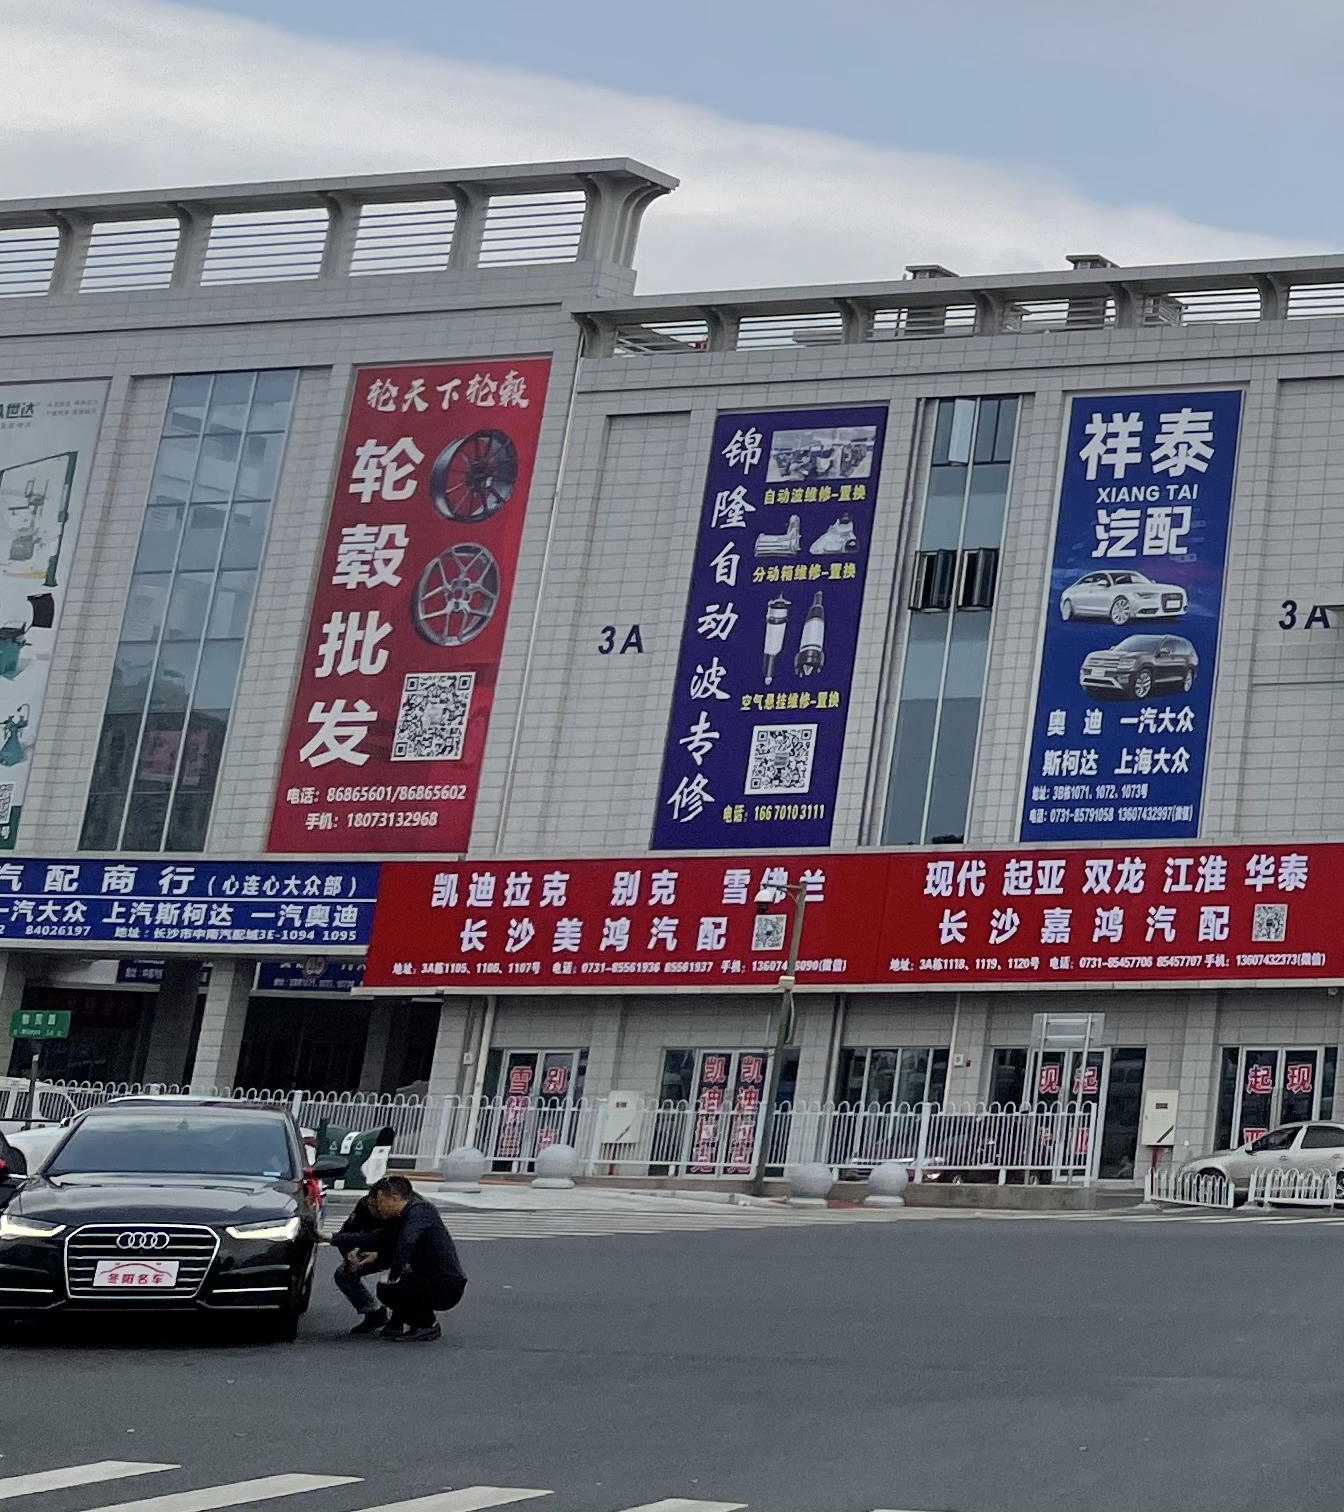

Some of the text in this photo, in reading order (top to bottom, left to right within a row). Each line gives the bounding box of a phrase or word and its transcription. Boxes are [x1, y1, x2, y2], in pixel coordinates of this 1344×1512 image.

[0, 401, 35, 419] 世达
[1078, 406, 1217, 481] 祥泰
[1095, 482, 1199, 505] XIANG TAI
[1091, 505, 1194, 559] 汽配
[299, 434, 426, 769] 轮毂批发
[1278, 599, 1331, 630] 3A
[597, 624, 645, 656] 3A
[666, 426, 763, 824] 锦隆自动波专修
[1120, 706, 1196, 734] 一汽大众
[1042, 746, 1191, 777] 斯柯达 上海大众
[430, 870, 570, 909] 凯迪拉克
[610, 868, 679, 907] 别克
[923, 852, 1309, 897] 现代 起亚 双龙 江淮 华泰
[24, 925, 91, 937] 84026197
[101, 901, 234, 927] 上汽斯柯达
[250, 903, 359, 928] 一汽奥迪
[938, 906, 1230, 944] 长沙嘉鸿汽配
[459, 915, 728, 953] 长沙美鸿汽配
